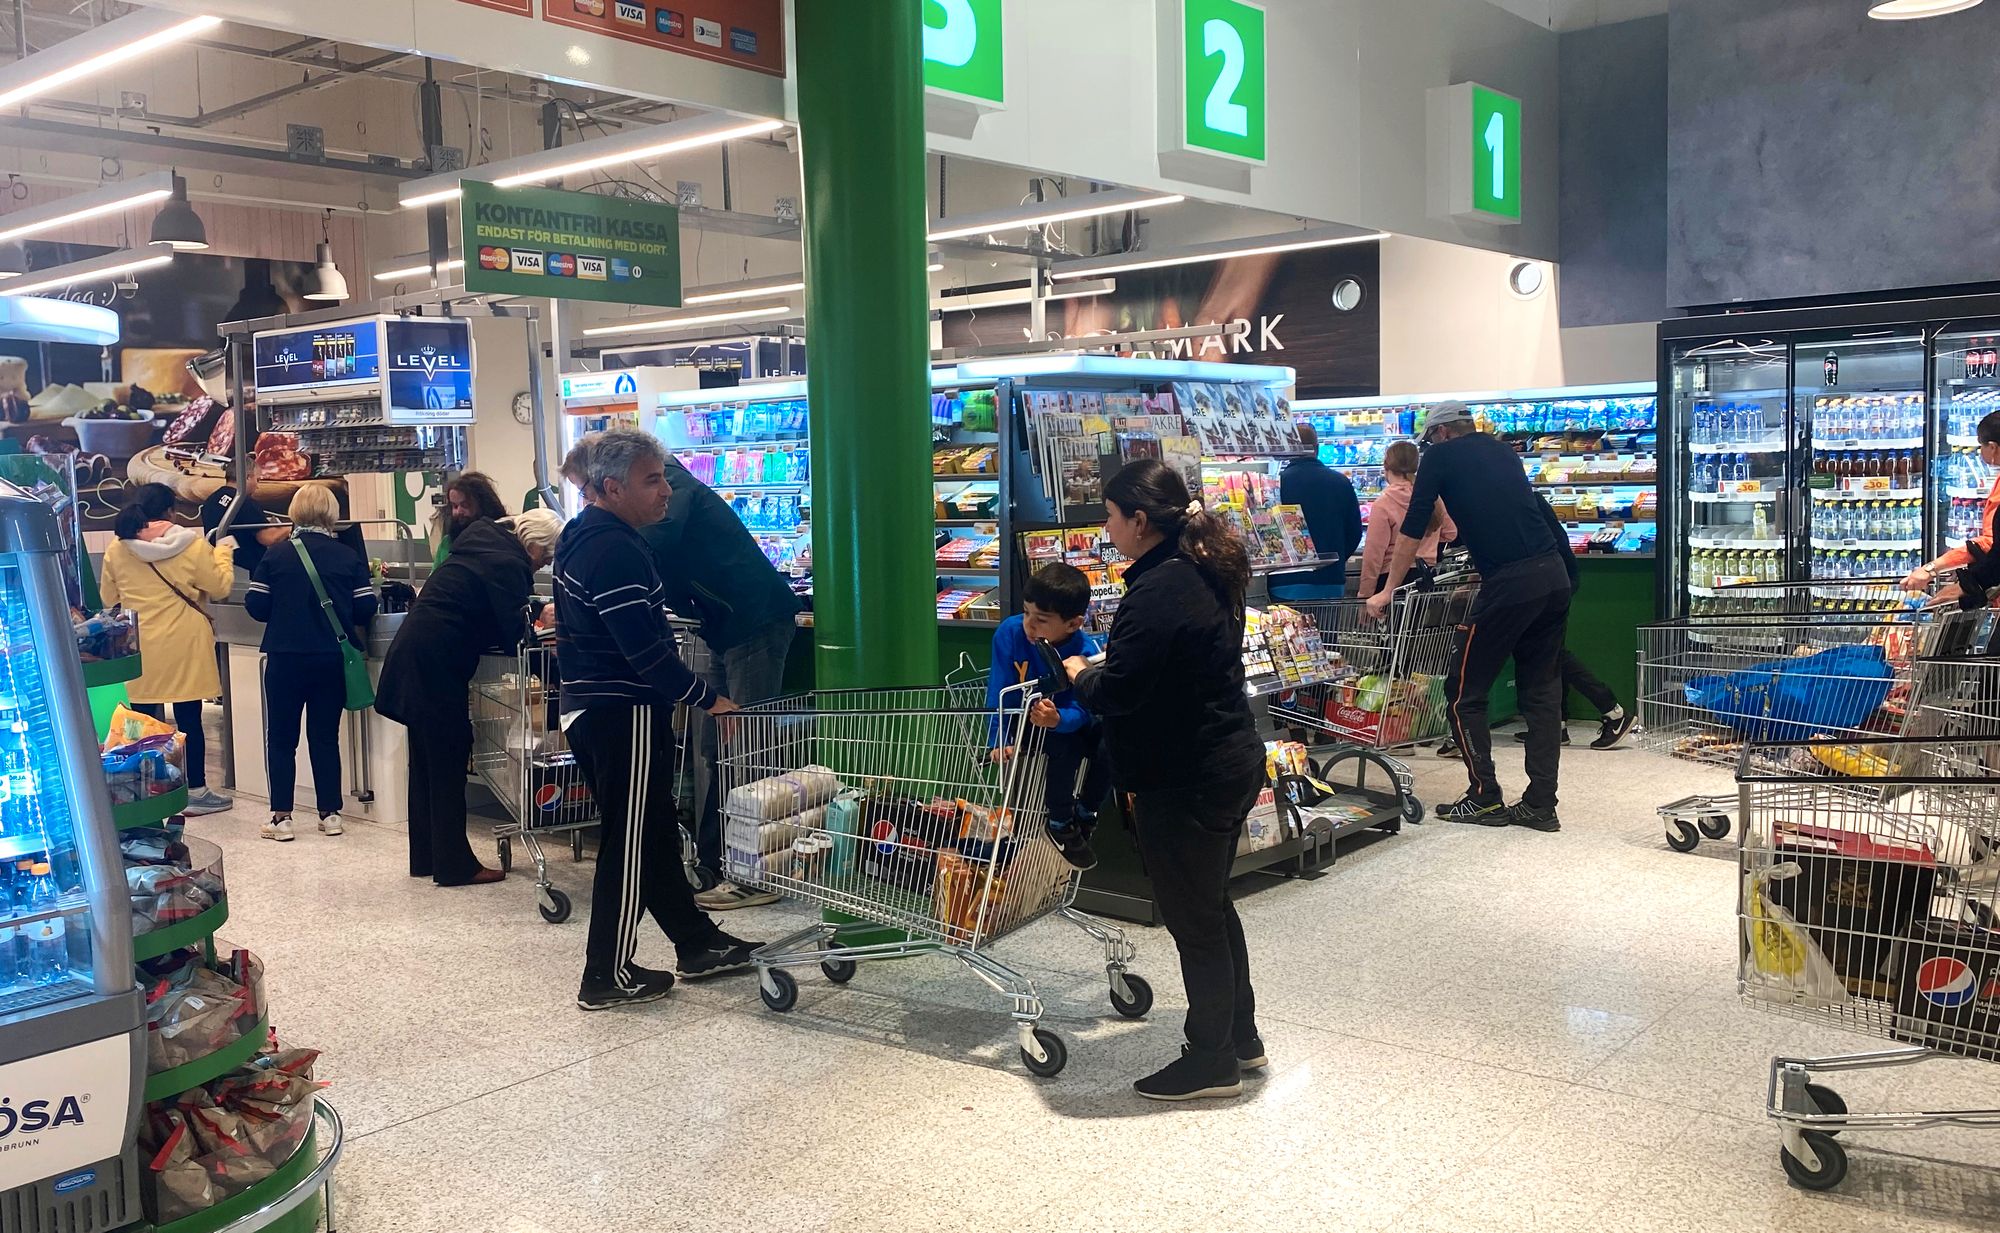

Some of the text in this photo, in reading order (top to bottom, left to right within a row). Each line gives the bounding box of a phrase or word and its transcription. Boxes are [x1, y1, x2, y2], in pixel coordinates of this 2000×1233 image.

[618, 5, 643, 22] VISA
[659, 16, 682, 29] Maestro
[1203, 18, 1248, 137] 2
[1484, 111, 1504, 200] 1
[475, 201, 669, 243] KONTANTFRI KASSA
[476, 224, 669, 256] ENDAST FÖR BETALNING MED KORT.
[480, 253, 510, 264] MasterCard
[516, 255, 540, 268] VISA
[550, 260, 574, 269] Maestro
[582, 261, 603, 273] VISA
[274, 353, 299, 369] LEVEL
[397, 353, 461, 375] LEVEL
[1336, 706, 1366, 723] Coca-Cola
[1255, 791, 1273, 807] OKU
[0, 1139, 39, 1152] BRUNN
